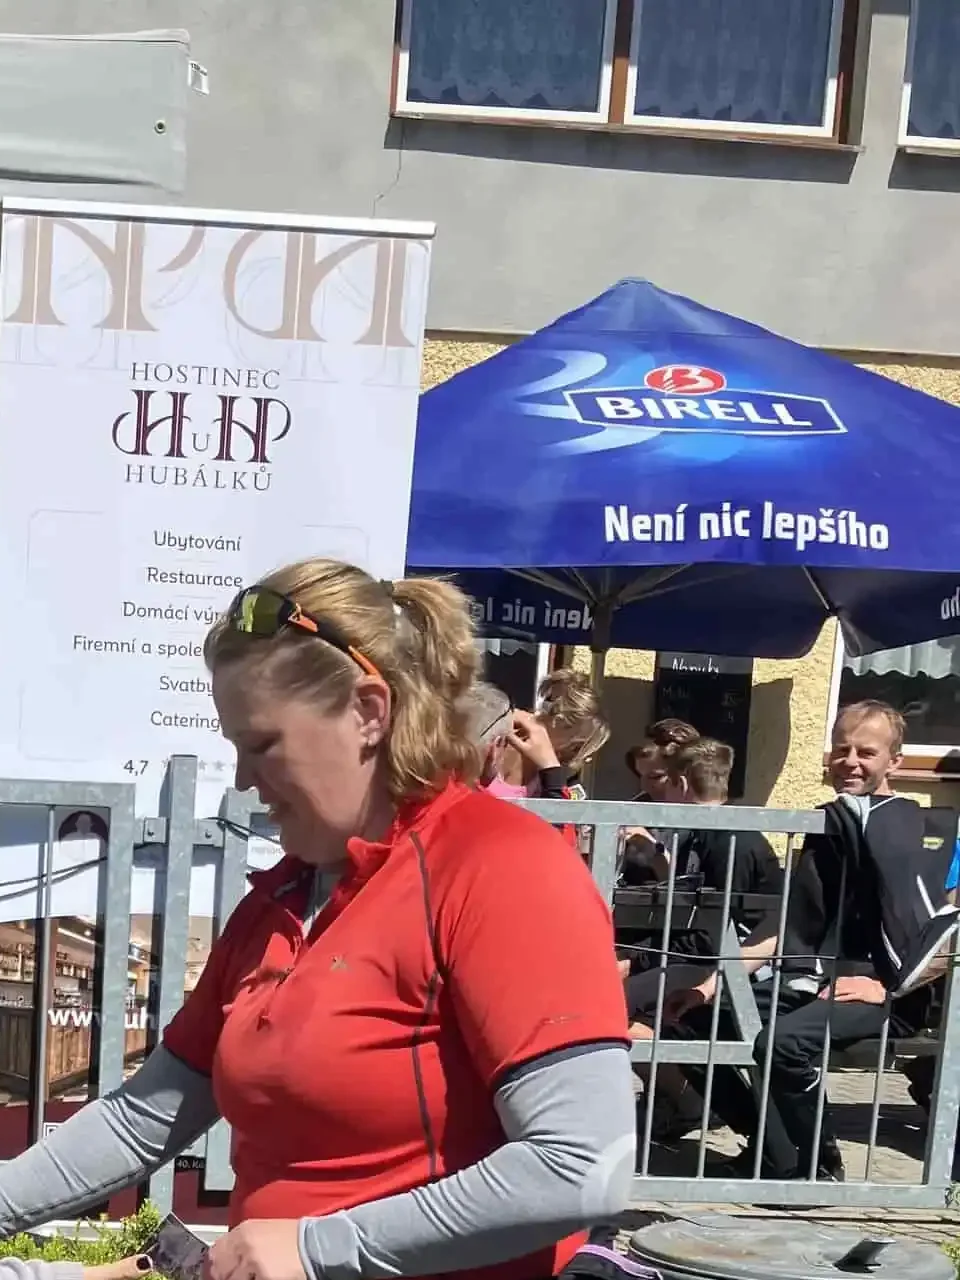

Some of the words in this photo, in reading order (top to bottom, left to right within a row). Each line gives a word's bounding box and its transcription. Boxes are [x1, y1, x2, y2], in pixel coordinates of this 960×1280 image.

[130, 362, 280, 390] HOSTINEC
[598, 396, 813, 427] BIRELL
[125, 464, 273, 491] HUBÁLKŮ
[603, 503, 689, 542] Není
[699, 502, 751, 540] nic
[762, 501, 889, 551] lepšího
[153, 530, 242, 552] Ubytování
[147, 566, 243, 588] Restaurace
[123, 601, 190, 621] Domácí
[194, 605, 220, 625] výr
[73, 635, 137, 653] Firemní
[142, 642, 152, 654] a
[158, 641, 204, 658] spole
[150, 710, 221, 732] Catering
[123, 759, 149, 776] 4,7
